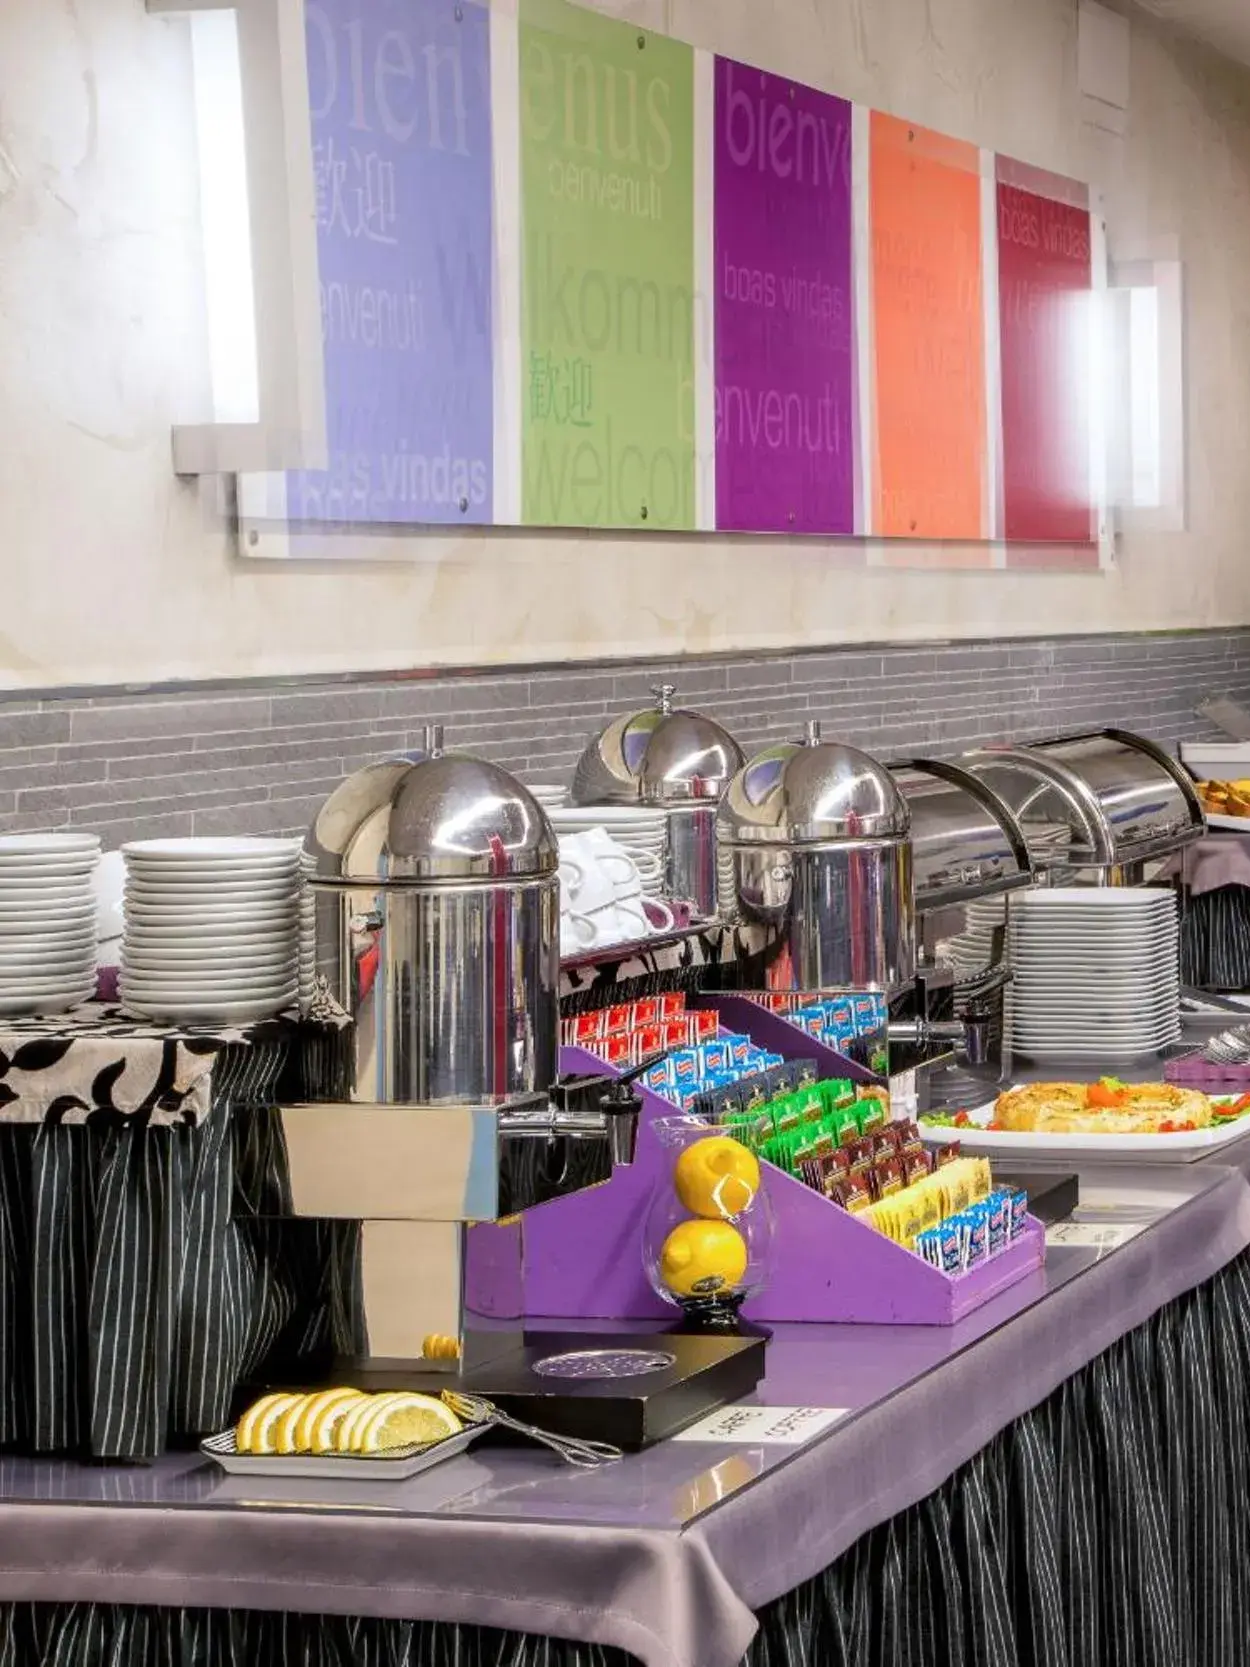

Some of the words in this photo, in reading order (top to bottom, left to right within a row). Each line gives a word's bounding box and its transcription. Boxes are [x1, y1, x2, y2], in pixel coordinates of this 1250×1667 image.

[725, 251, 777, 308] boas
[780, 262, 844, 320] vindas
[529, 348, 594, 428] 歡迎
[382, 430, 488, 507] vindas
